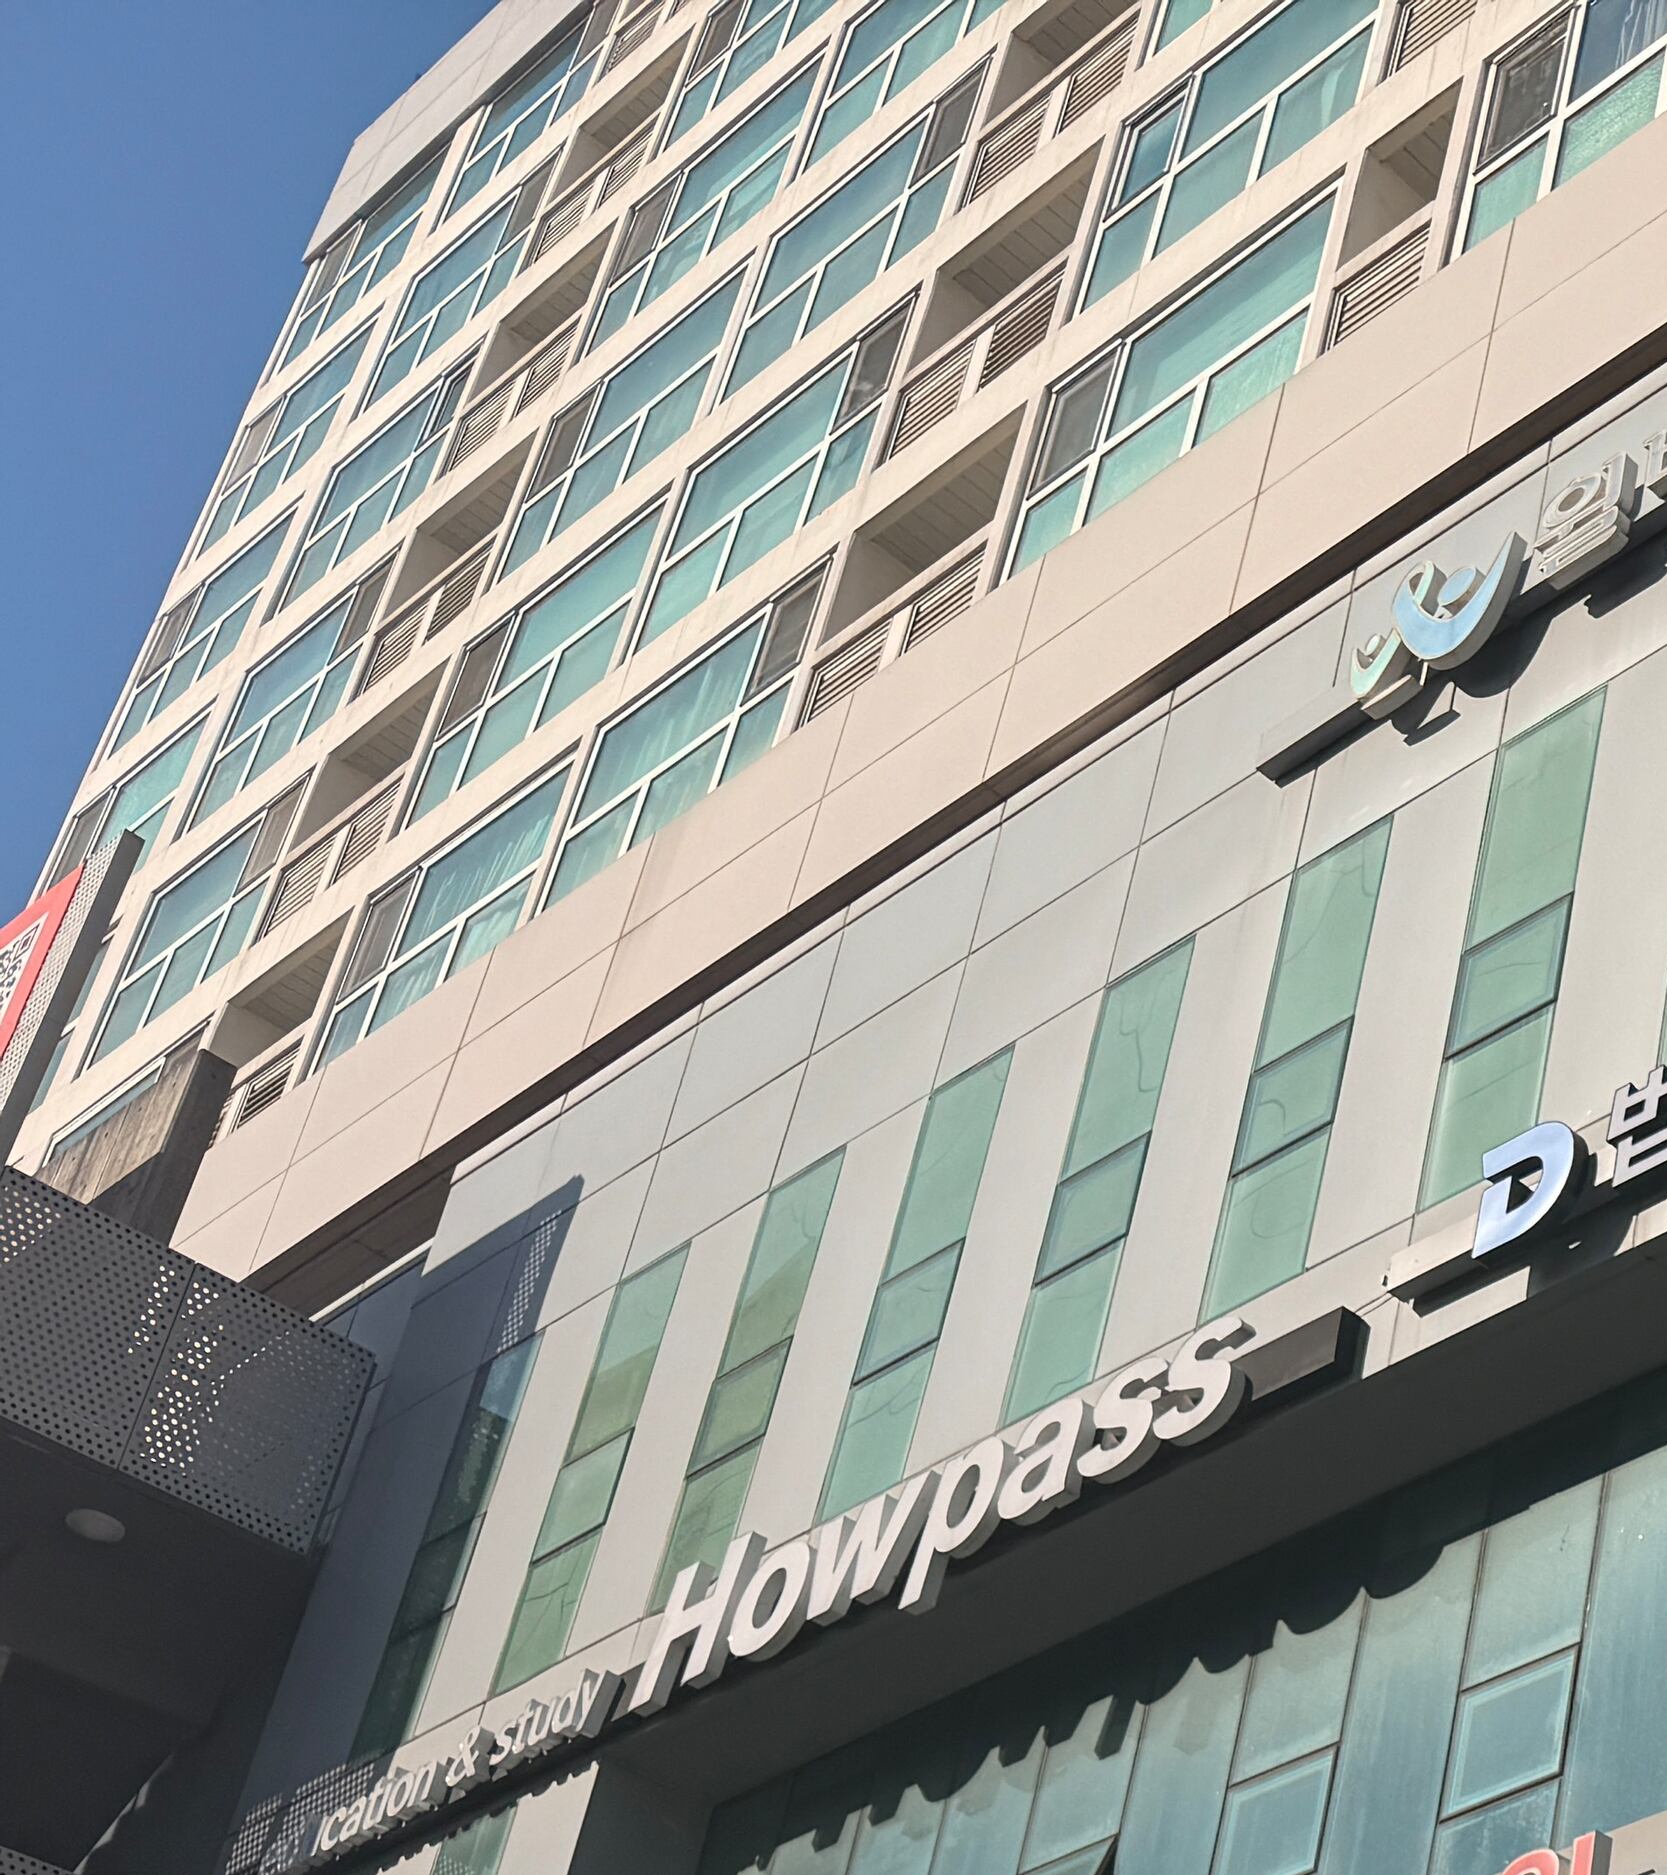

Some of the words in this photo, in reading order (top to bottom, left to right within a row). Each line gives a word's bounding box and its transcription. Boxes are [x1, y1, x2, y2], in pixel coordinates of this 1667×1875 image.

[631, 1316, 1256, 1714] Howpass
[446, 1726, 482, 1788] &
[490, 1669, 606, 1766] study
